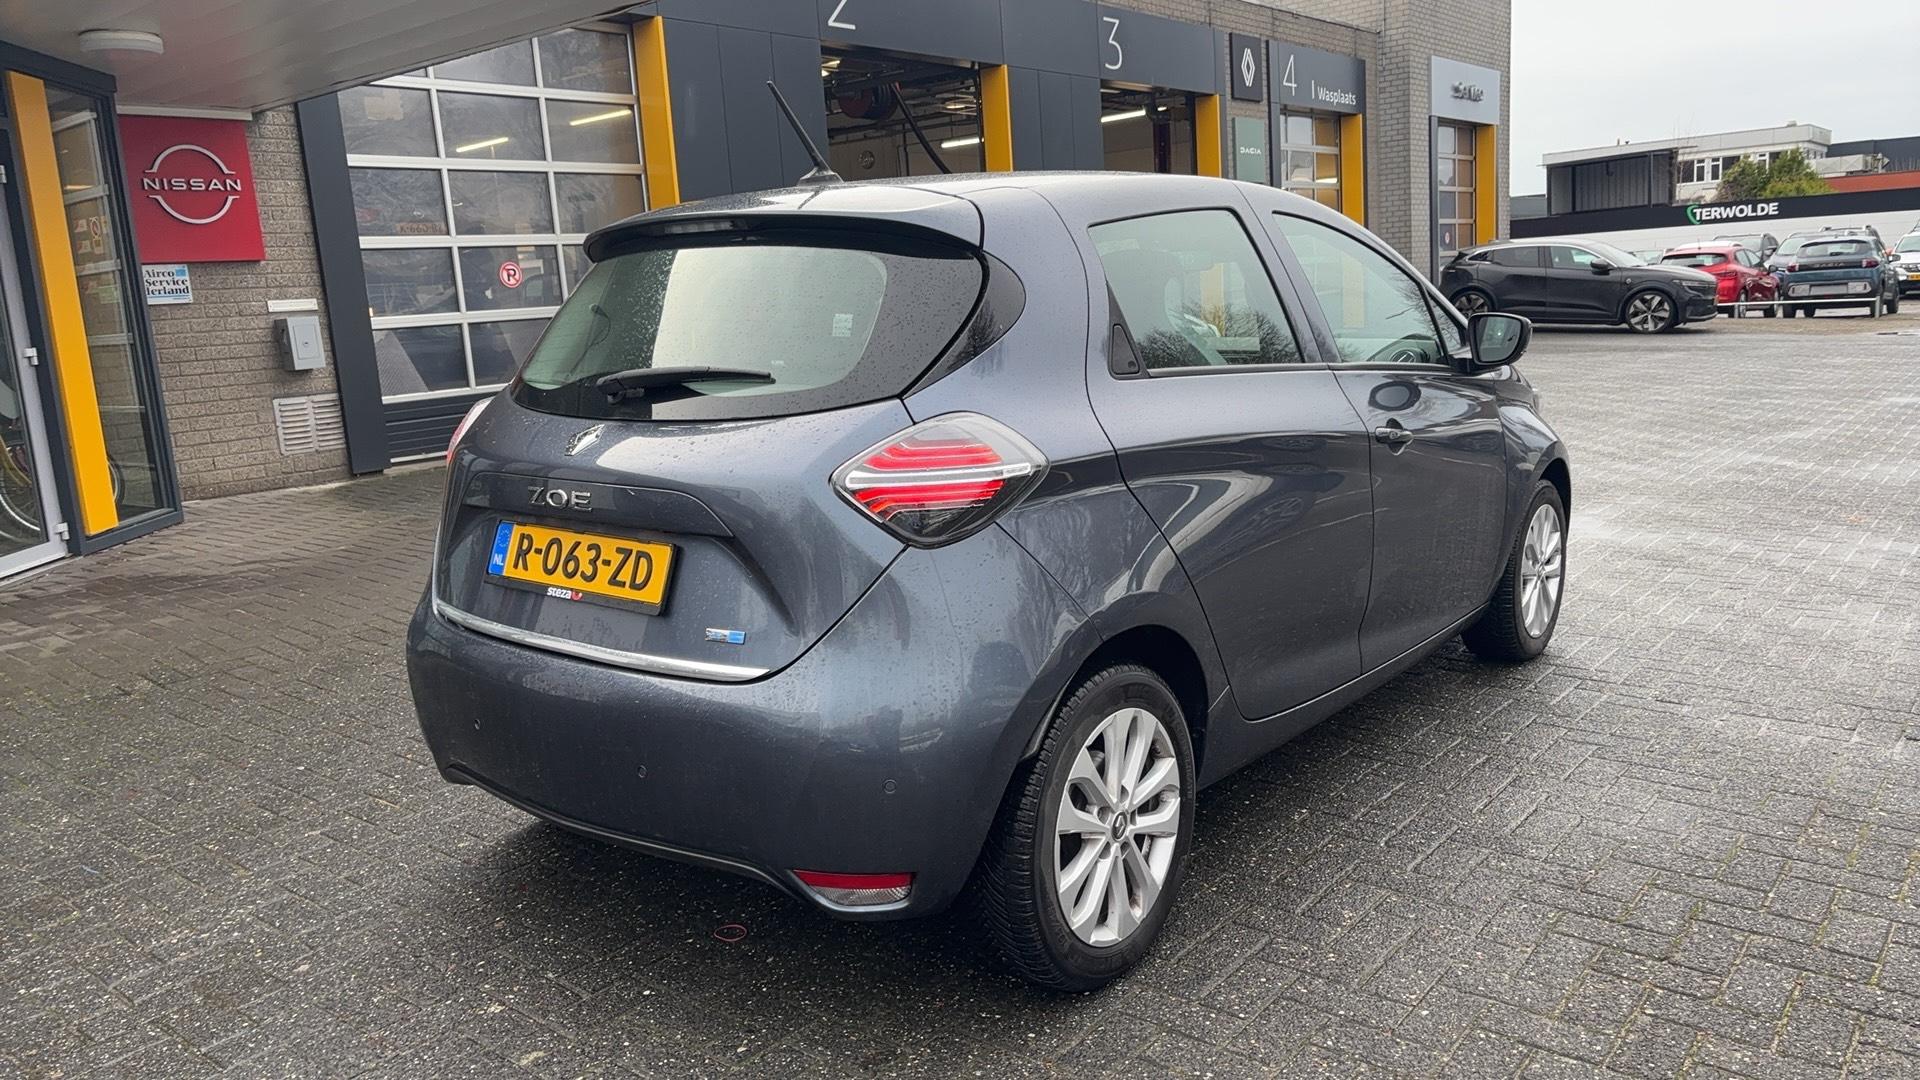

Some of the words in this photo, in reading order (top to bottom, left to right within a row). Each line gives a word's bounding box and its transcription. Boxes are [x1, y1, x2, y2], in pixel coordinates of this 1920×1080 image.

[1103, 16, 1123, 71] 3
[1283, 54, 1297, 97] 4
[1317, 86, 1357, 106] Wasplaats
[1240, 146, 1262, 155] DACIA
[143, 178, 242, 191] NISSAN
[1693, 202, 1779, 221] TERWOLDE
[144, 269, 175, 278] Airco
[145, 277, 188, 287] Service
[527, 486, 593, 512] ZOE
[492, 553, 504, 566] NL
[512, 532, 654, 592] R-063-ZD
[546, 586, 572, 600] steza
